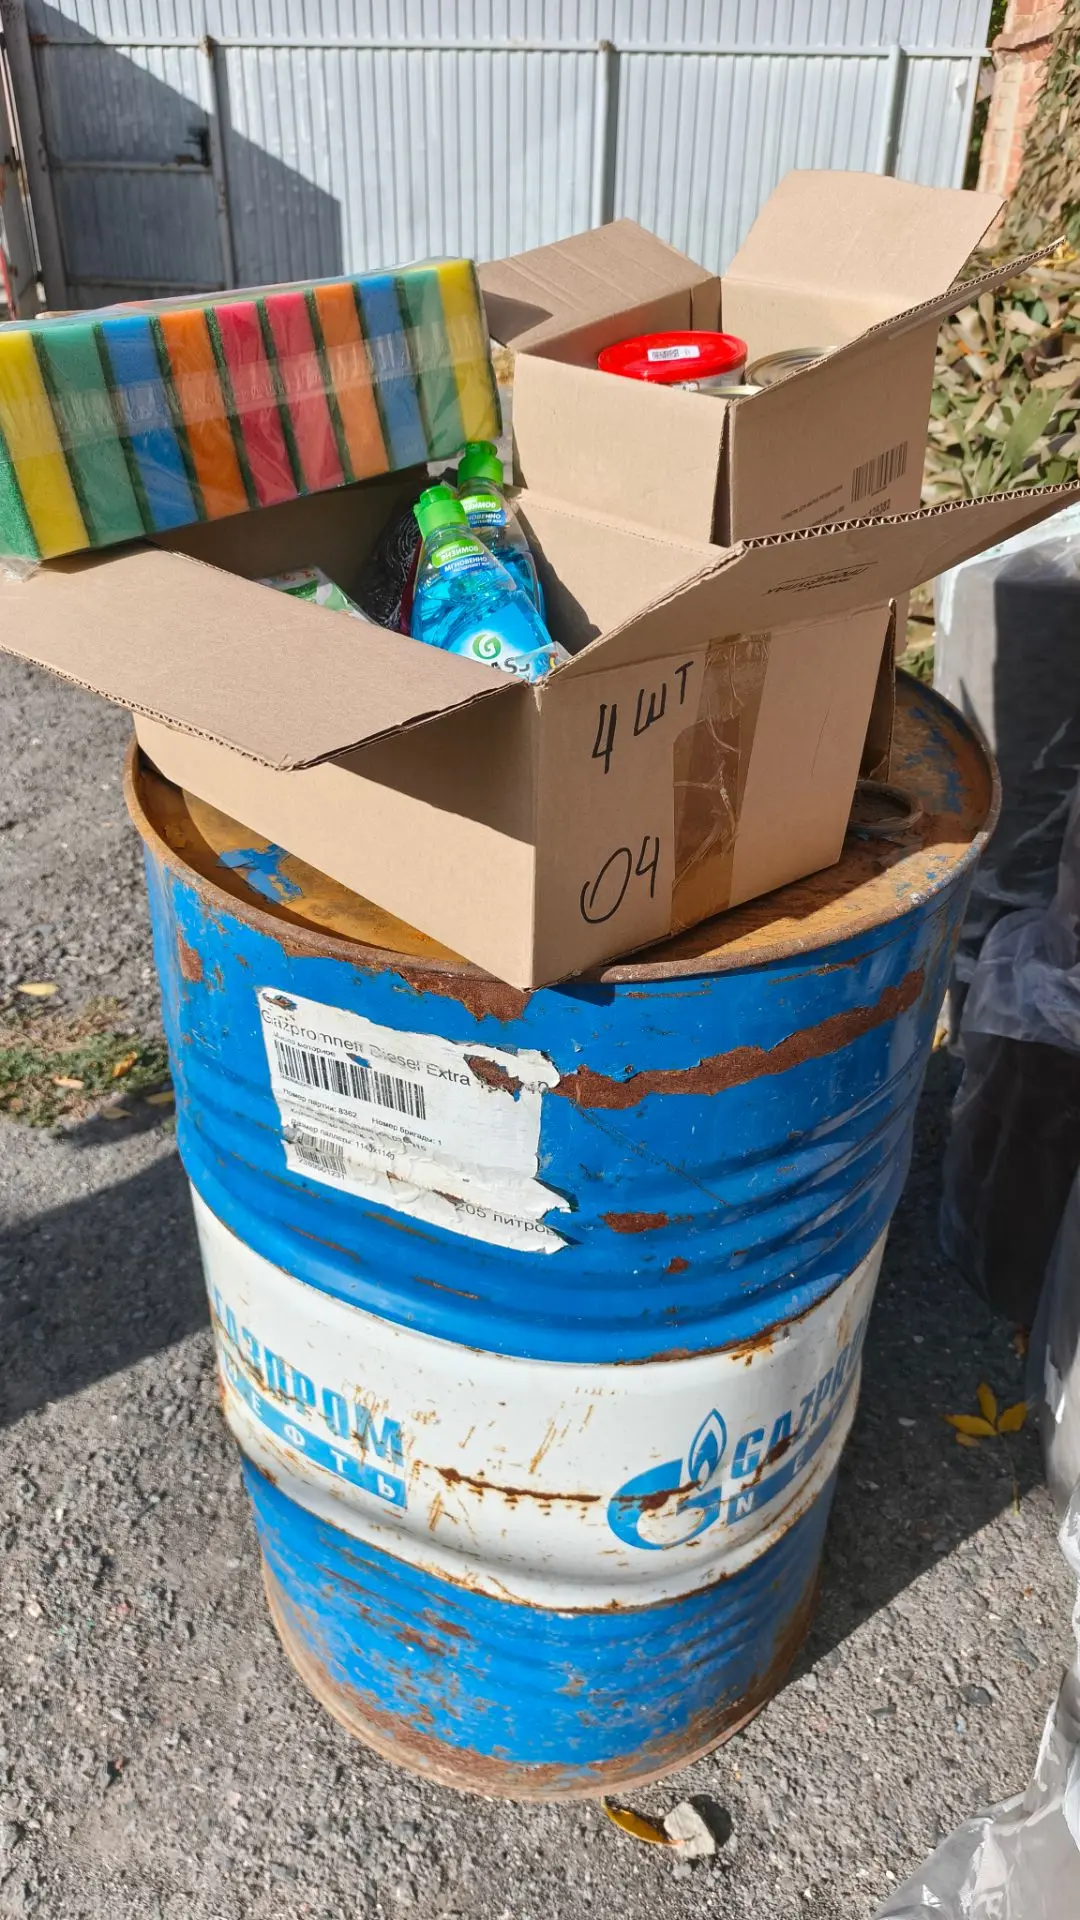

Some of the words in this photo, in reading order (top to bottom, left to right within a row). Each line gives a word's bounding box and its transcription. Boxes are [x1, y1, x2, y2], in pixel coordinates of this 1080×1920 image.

[592, 703, 618, 775] 4
[369, 1043, 421, 1072] Diesel
[425, 1063, 472, 1087] Extra
[371, 1117, 399, 1132] Номер
[455, 1202, 487, 1219] 205
